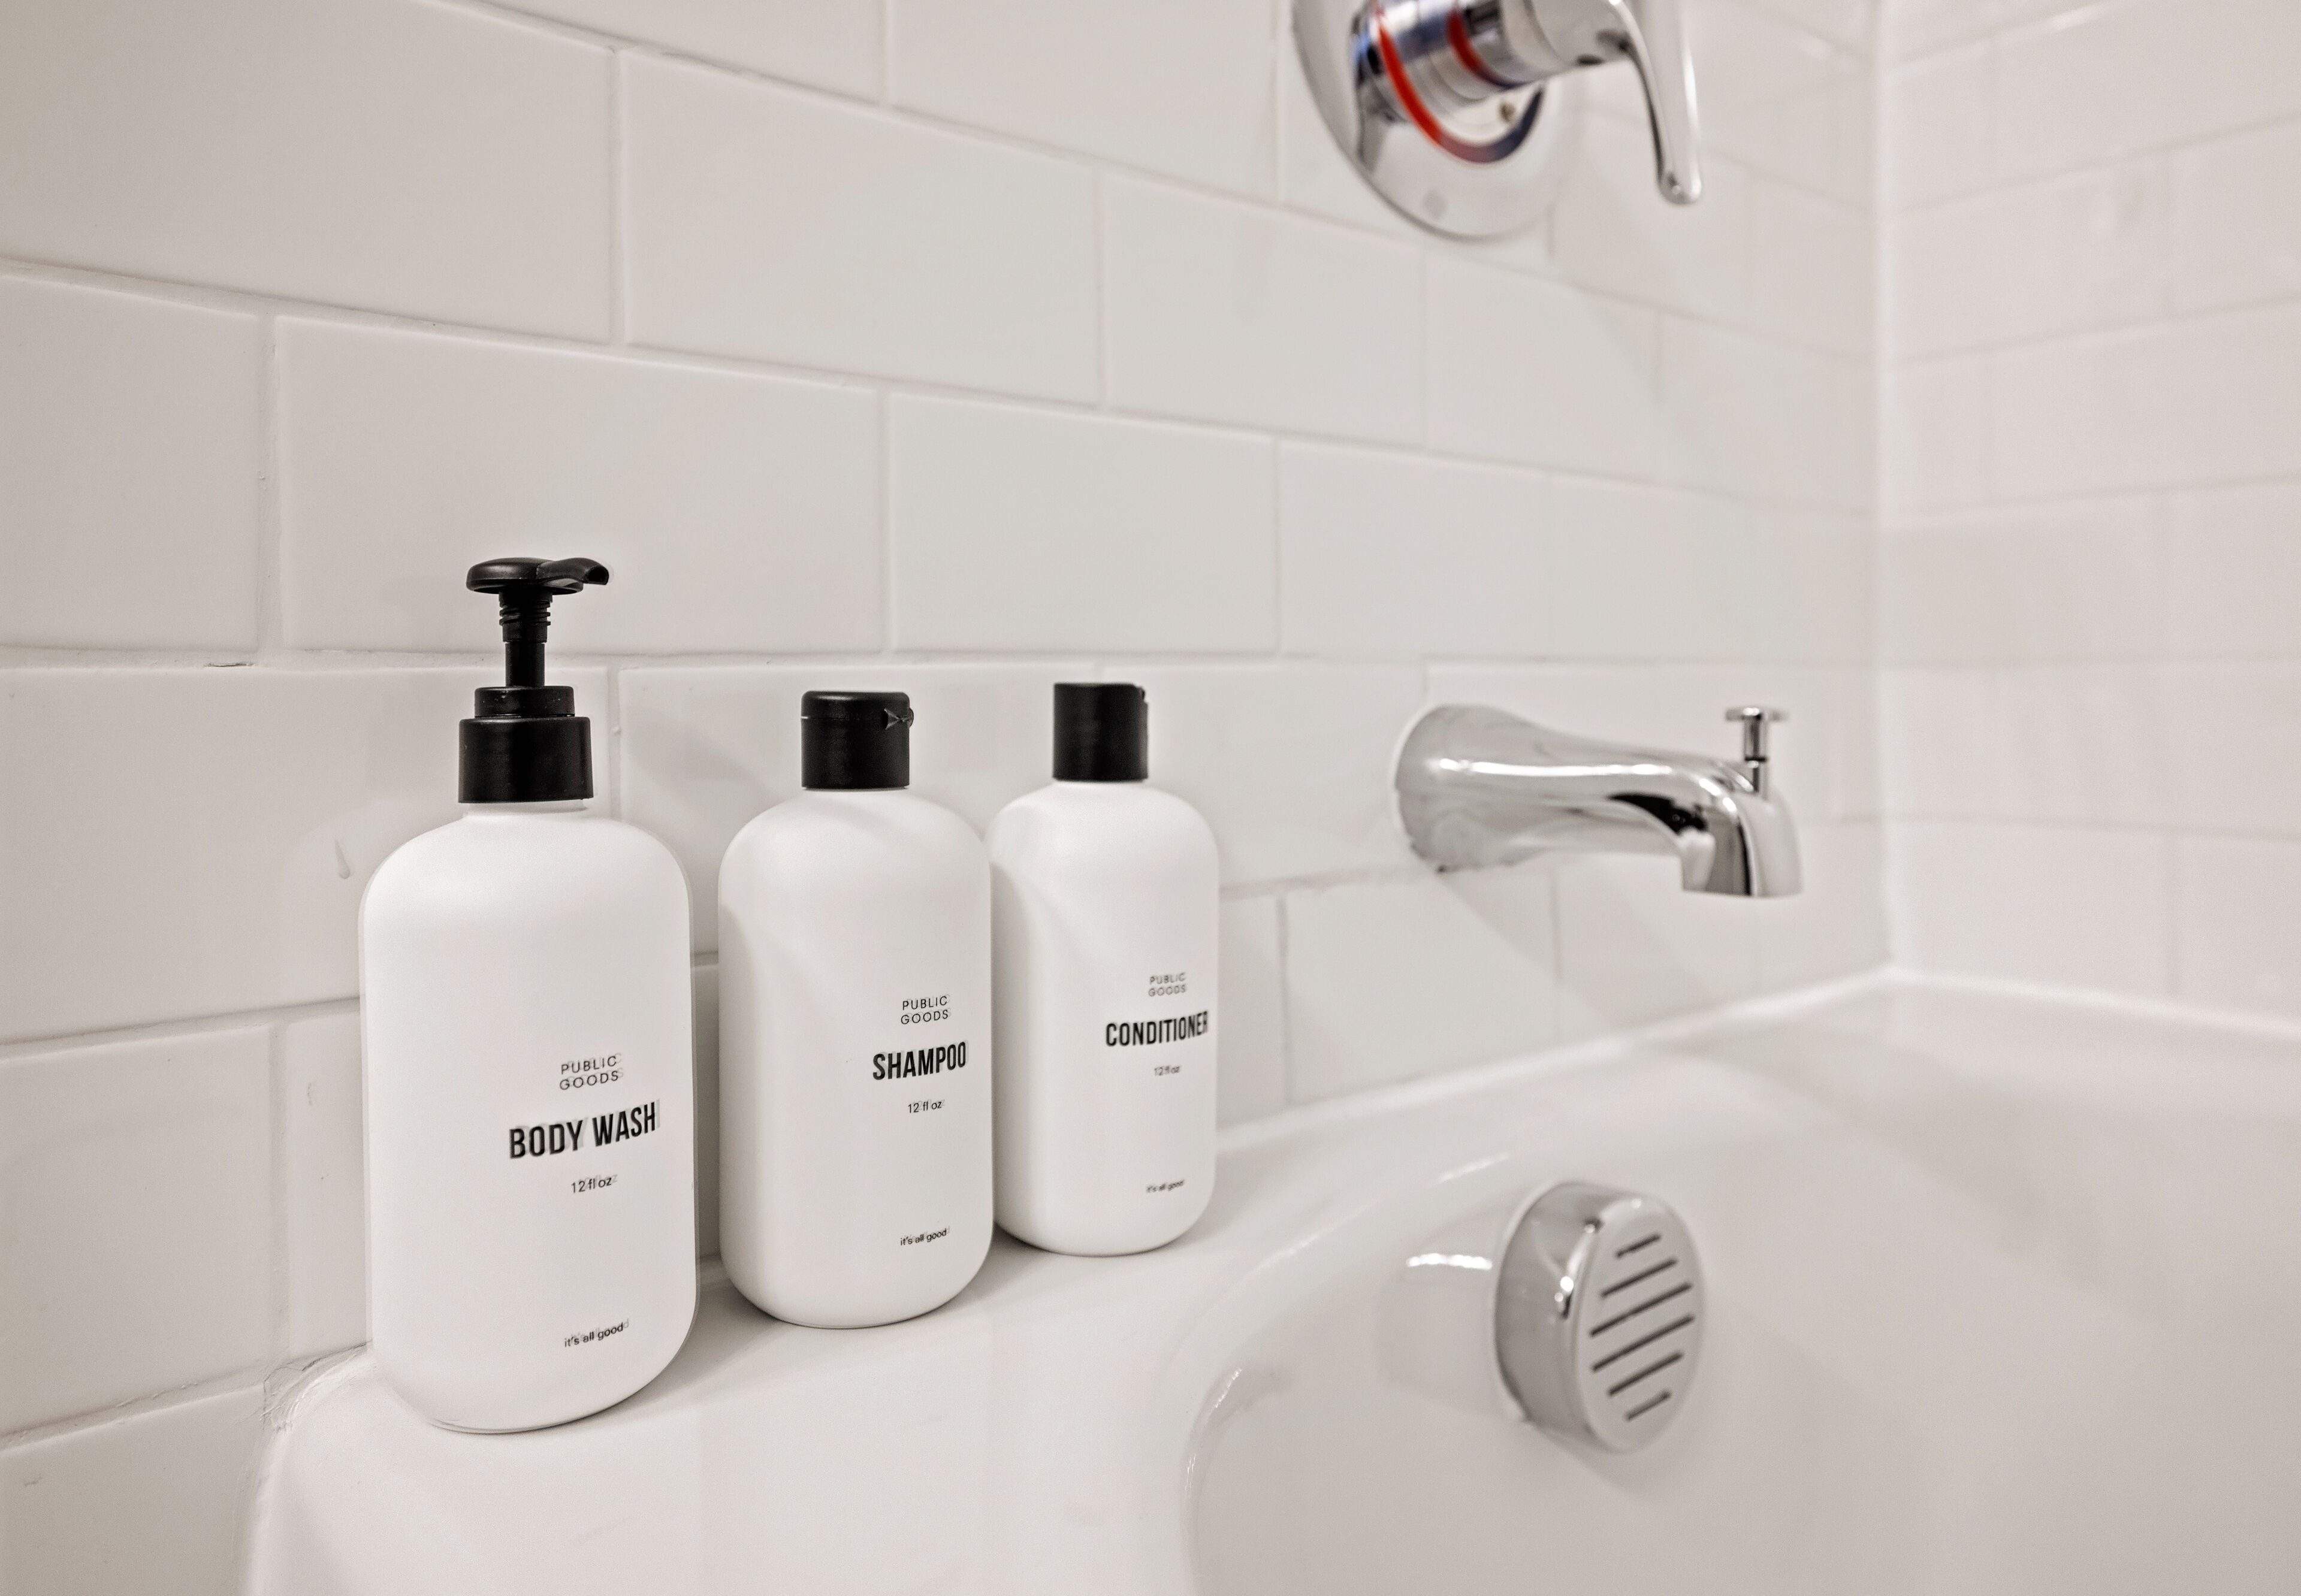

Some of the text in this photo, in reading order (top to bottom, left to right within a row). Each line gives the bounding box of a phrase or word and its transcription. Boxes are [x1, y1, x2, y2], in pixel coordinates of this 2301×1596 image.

[1149, 972, 1186, 985] PUBLIC
[1148, 984, 1186, 998] GOODS
[902, 995, 947, 1011] PUBLIC
[901, 1009, 949, 1024] GOODS
[1106, 1010, 1208, 1047] CONDITIONER
[561, 1055, 618, 1075] PUBLIC
[872, 1041, 967, 1080] SHAMPOO
[559, 1070, 619, 1090] GOODS
[908, 1101, 942, 1114] 12 fl oz
[509, 1101, 656, 1159] BODY WASH
[571, 1177, 612, 1193] 12 fl oz
[915, 1234, 924, 1243] all
[926, 1228, 947, 1243] good
[564, 1322, 623, 1347] it's all good
